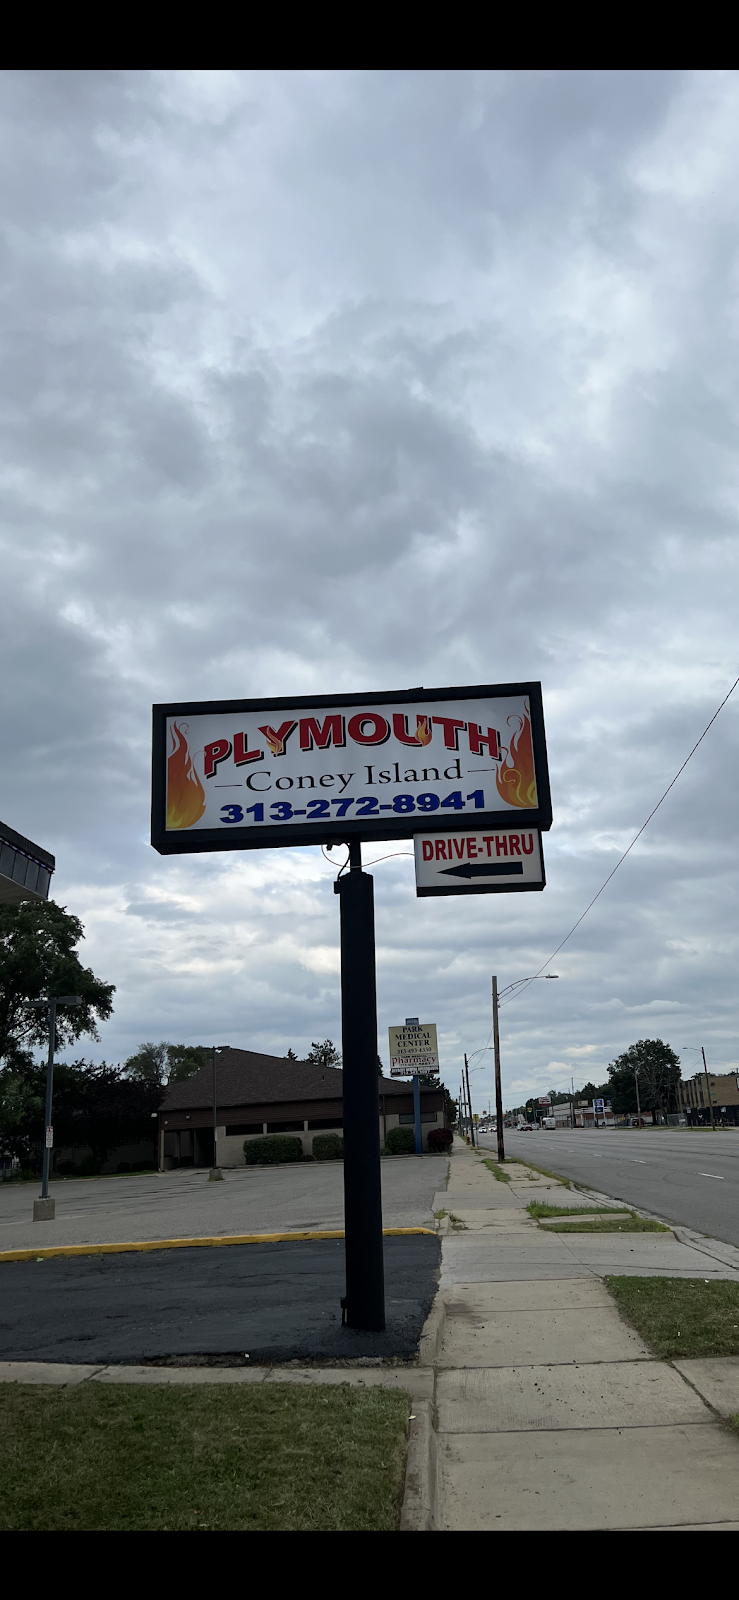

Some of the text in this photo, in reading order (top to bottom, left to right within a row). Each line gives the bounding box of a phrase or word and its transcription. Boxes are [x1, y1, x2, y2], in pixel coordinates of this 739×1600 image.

[204, 712, 502, 779] PLYMOUTH
[246, 758, 464, 793] Coney Island
[220, 790, 486, 824] 313-272-8941
[421, 833, 534, 861] DRIVE-THRU
[395, 1032, 431, 1040] MEDICAL
[397, 1040, 430, 1048] CENTER
